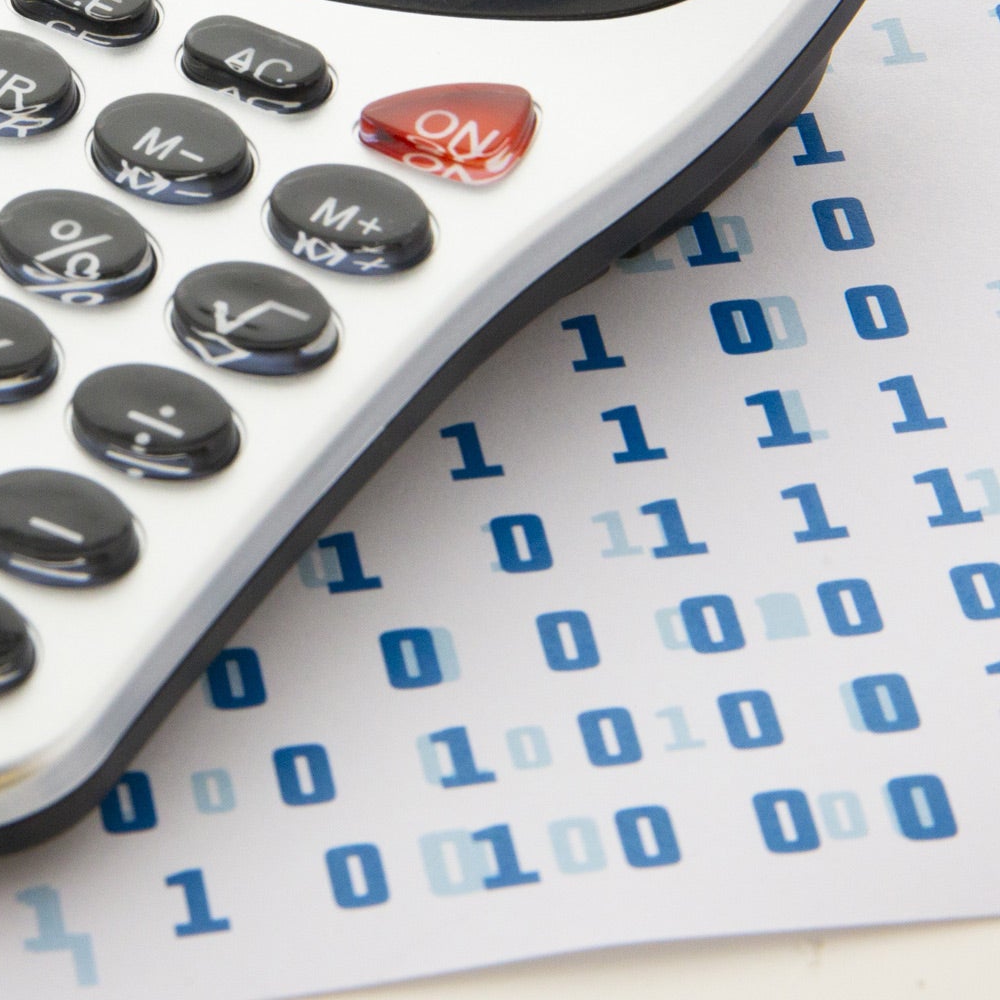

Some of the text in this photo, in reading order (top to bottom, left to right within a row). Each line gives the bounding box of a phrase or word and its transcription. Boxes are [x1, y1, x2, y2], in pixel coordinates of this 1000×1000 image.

[225, 47, 293, 83] AC
[415, 110, 500, 157] ON
[789, 112, 846, 166] 1
[310, 197, 384, 236] M+
[687, 211, 741, 267] 1
[811, 197, 875, 251] 0
[709, 299, 773, 356] 0
[844, 284, 909, 340] 0
[561, 314, 626, 373] 1
[601, 404, 668, 464] 1
[744, 389, 813, 449] 1
[878, 374, 947, 434] 1
[440, 422, 505, 480] 1
[780, 482, 850, 544] 1
[912, 467, 984, 528] 1
[490, 513, 553, 573] 0
[640, 498, 709, 559] 1
[317, 531, 382, 594] 1
[679, 594, 746, 654] 0
[816, 577, 884, 637] 0
[378, 627, 443, 690] 0
[535, 610, 601, 672] 0
[206, 647, 268, 710] 0
[852, 673, 920, 734] 0
[577, 706, 643, 768] 0
[716, 689, 784, 750] 0
[272, 743, 337, 807] 0
[430, 726, 497, 789] 1
[101, 770, 158, 834] 0
[751, 788, 821, 854] 0
[886, 774, 958, 841] 0
[471, 823, 541, 890] 1
[613, 804, 682, 869] 0
[165, 867, 231, 938] 1
[324, 843, 390, 909] 0
